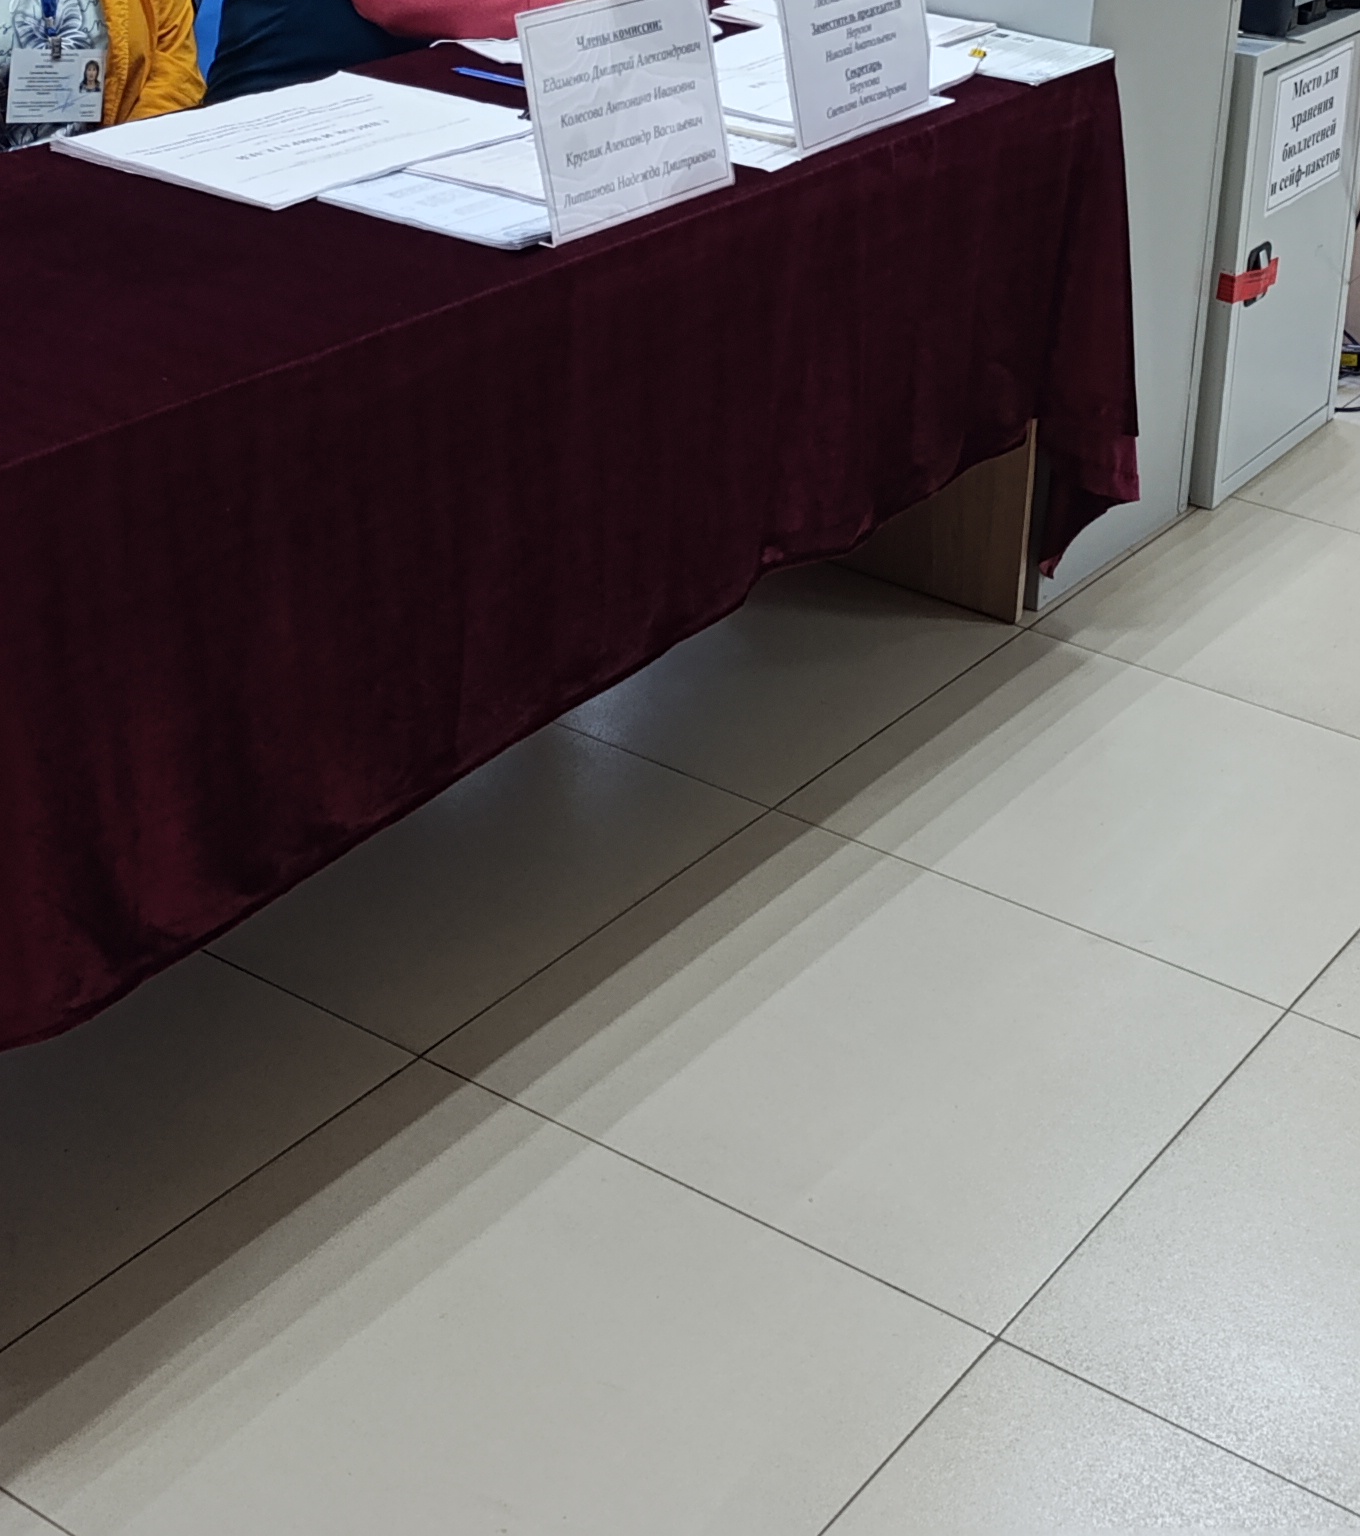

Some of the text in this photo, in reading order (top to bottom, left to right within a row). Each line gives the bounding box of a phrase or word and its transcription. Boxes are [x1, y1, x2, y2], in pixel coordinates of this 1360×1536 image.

[576, 19, 663, 52] Члены комиссии:
[591, 56, 635, 83] Дмитрий
[637, 41, 702, 66] Александрович
[1292, 66, 1340, 100] Место для
[560, 80, 696, 129] Колесова Антонина Ивановна
[1291, 96, 1335, 132] хранения
[566, 115, 703, 169] Круглик Александр Васильевич
[1282, 118, 1337, 162] бюллетеней
[563, 148, 717, 209] Литвинова Надежда Дмитриевна
[1270, 147, 1341, 196] и сейф-пакетов
